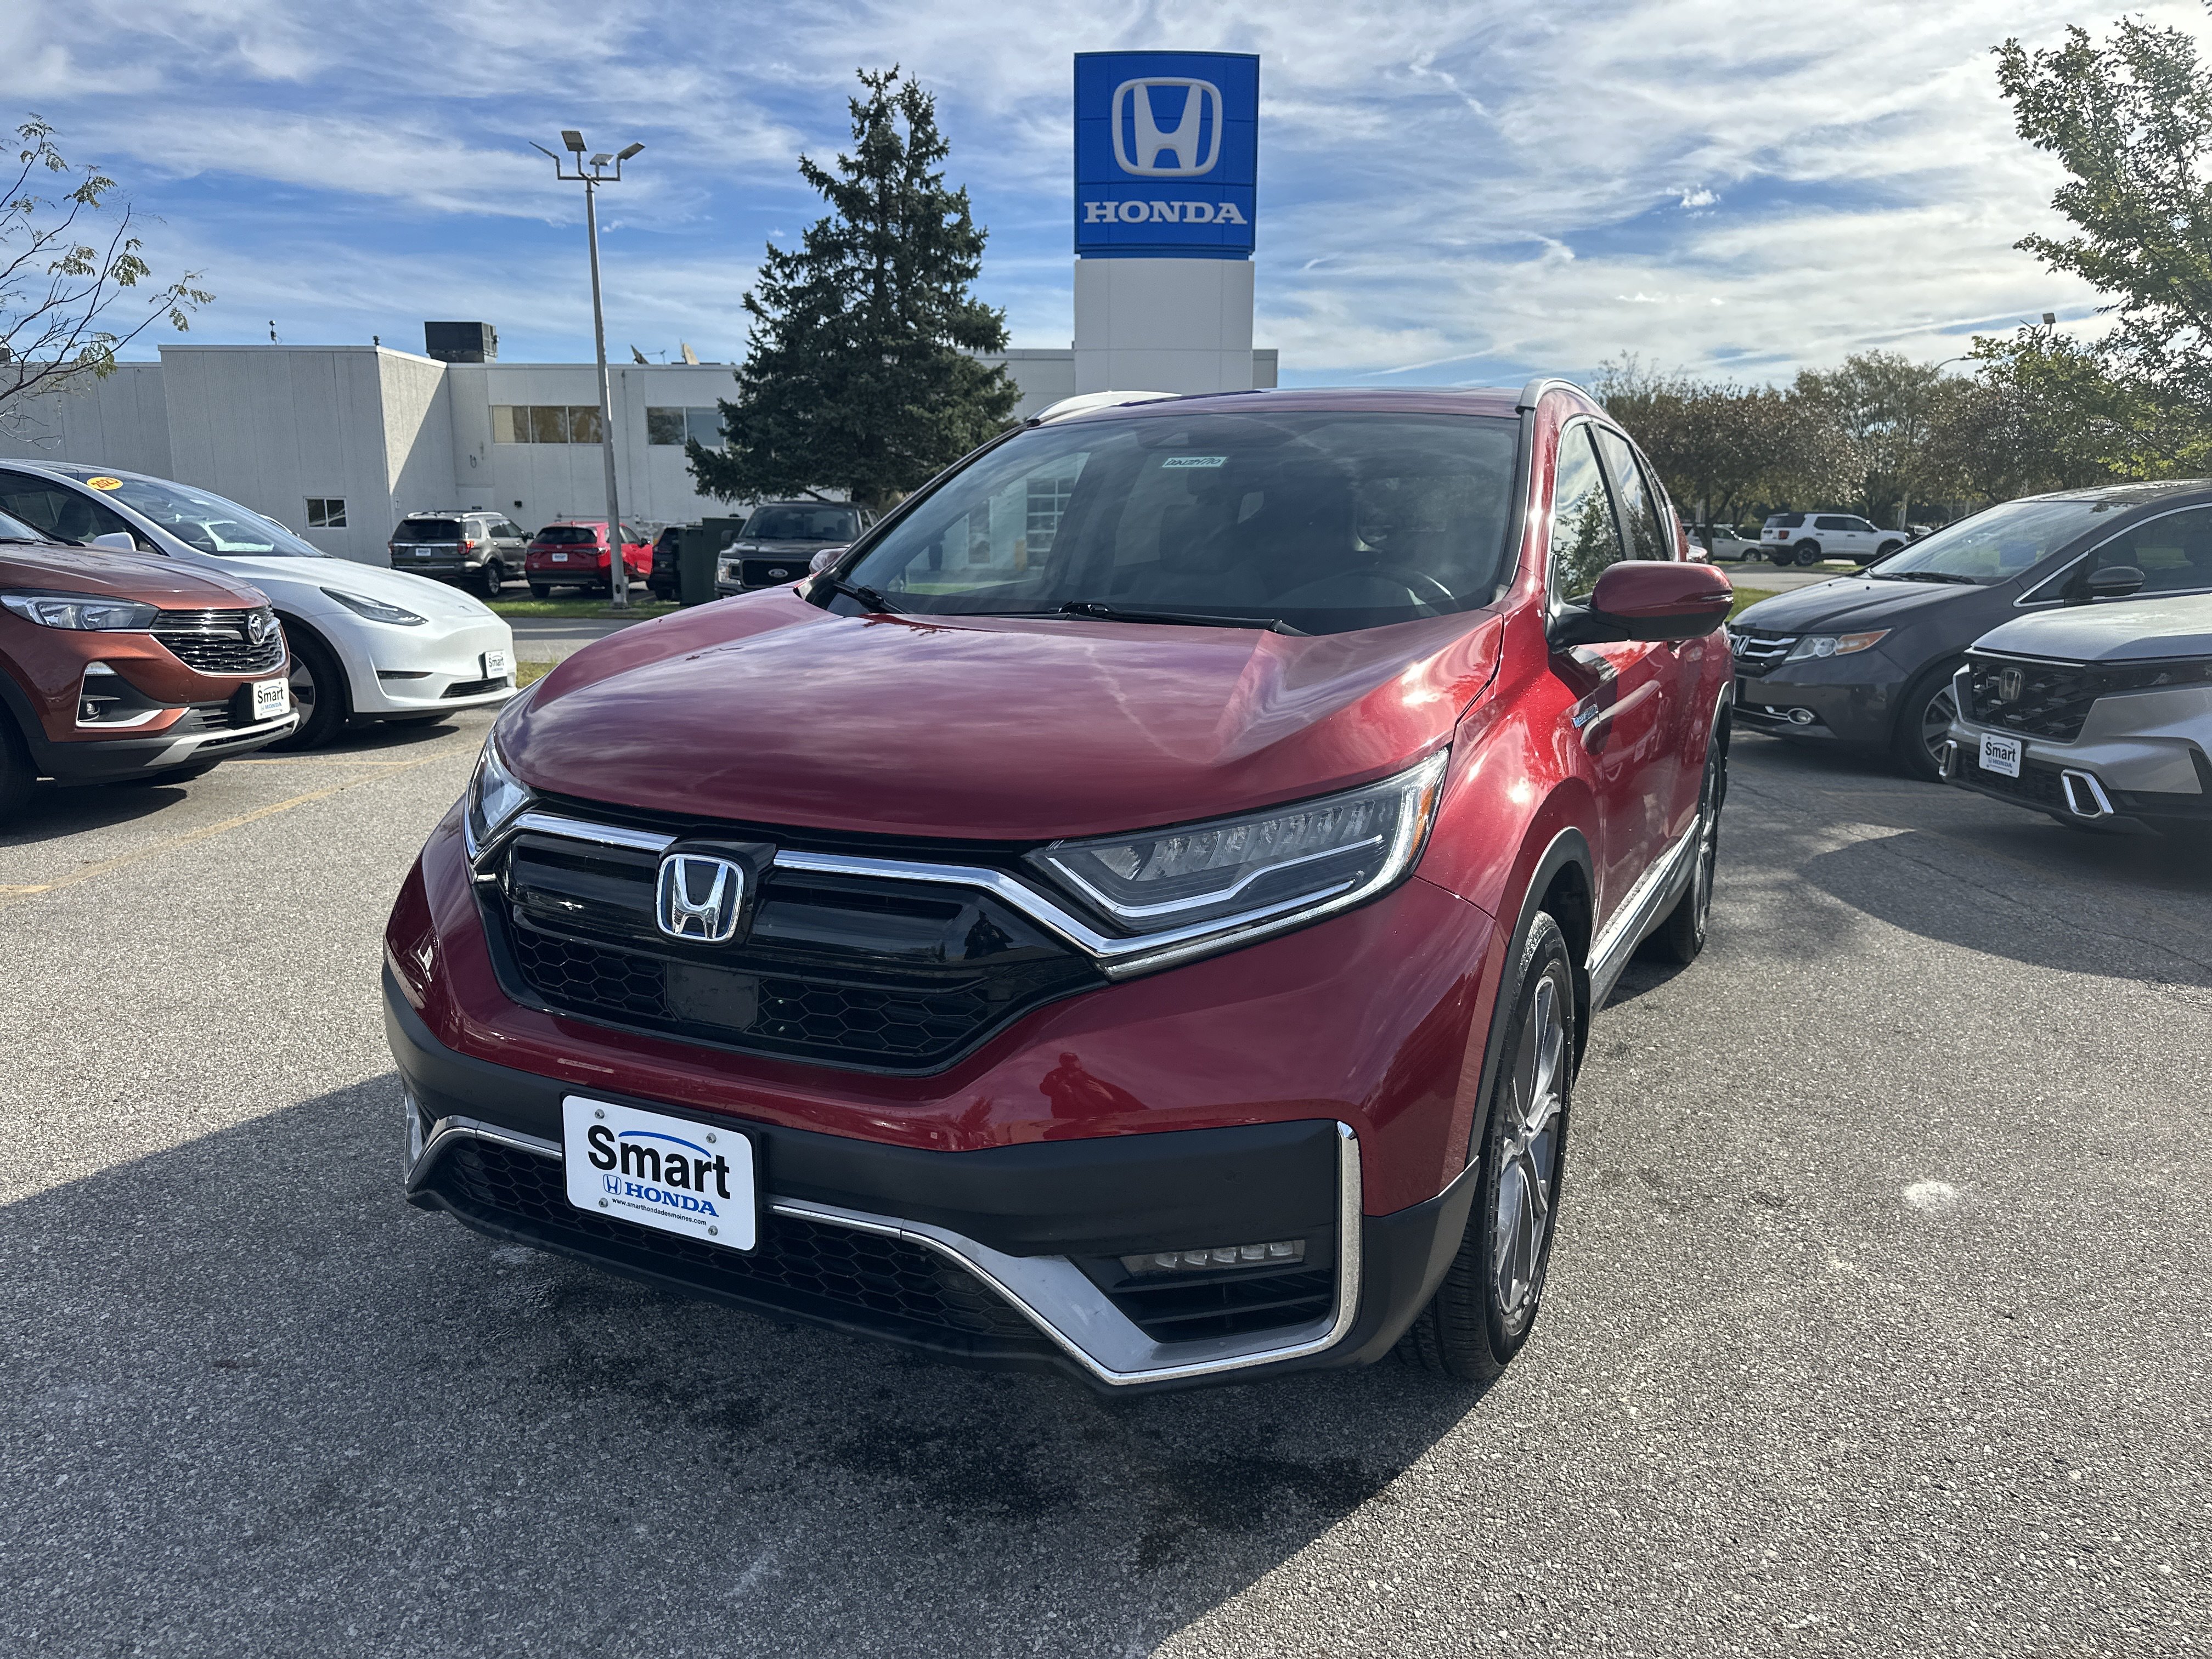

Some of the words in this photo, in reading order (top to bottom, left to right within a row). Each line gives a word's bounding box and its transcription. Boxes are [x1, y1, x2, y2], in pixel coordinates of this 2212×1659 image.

[1084, 200, 1248, 225] HONDA
[257, 687, 284, 704] Smart
[1985, 741, 2016, 763] Smart
[1993, 759, 2012, 769] HONDA
[588, 1124, 731, 1200] Smart
[624, 1181, 719, 1217] HONDA
[612, 1198, 707, 1226] www.smarthondadesmoines.com
